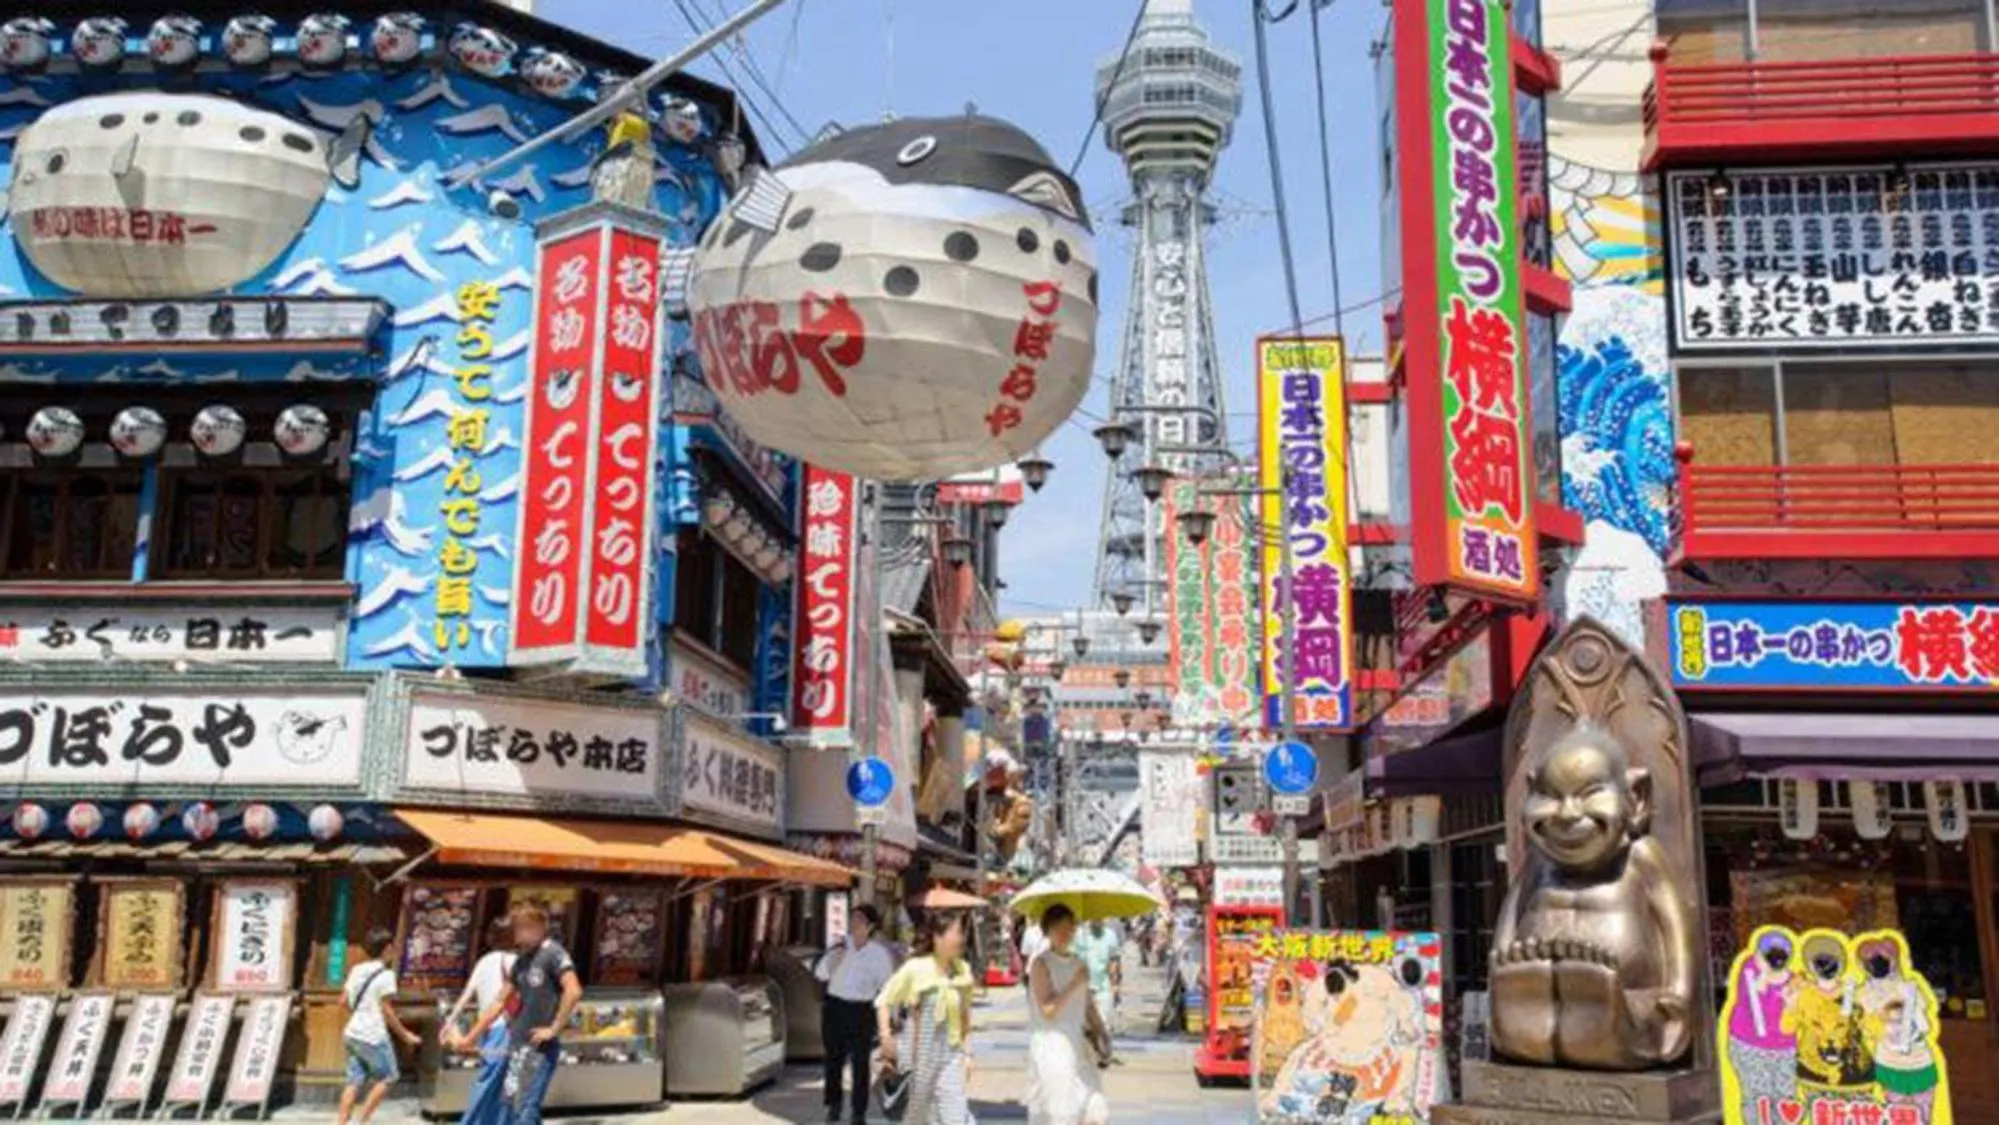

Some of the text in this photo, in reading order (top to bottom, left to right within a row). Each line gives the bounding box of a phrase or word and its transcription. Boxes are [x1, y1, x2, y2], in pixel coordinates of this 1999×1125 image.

[550, 255, 589, 352] 名物
[610, 254, 654, 353] 名物
[1687, 255, 1712, 337] もち
[1772, 255, 1801, 337] にんにく
[1802, 254, 1831, 335] 玉ねぎ
[1832, 252, 1861, 333] 山芋
[1891, 251, 1923, 333] れんこん
[1920, 250, 1952, 332] 銀杏
[1951, 249, 1984, 331] 白ねぎ
[1446, 299, 1520, 525] 横綱
[530, 421, 578, 626] てっちり
[595, 421, 644, 626] てっちり
[1463, 529, 1522, 581] 酒処
[1272, 563, 1341, 690] 横綱
[1709, 621, 1892, 663] 日本一の串かつ
[0, 700, 256, 768] づぼらや
[420, 720, 649, 775] づぼらや本店
[1254, 932, 1395, 963] 大阪新世界
